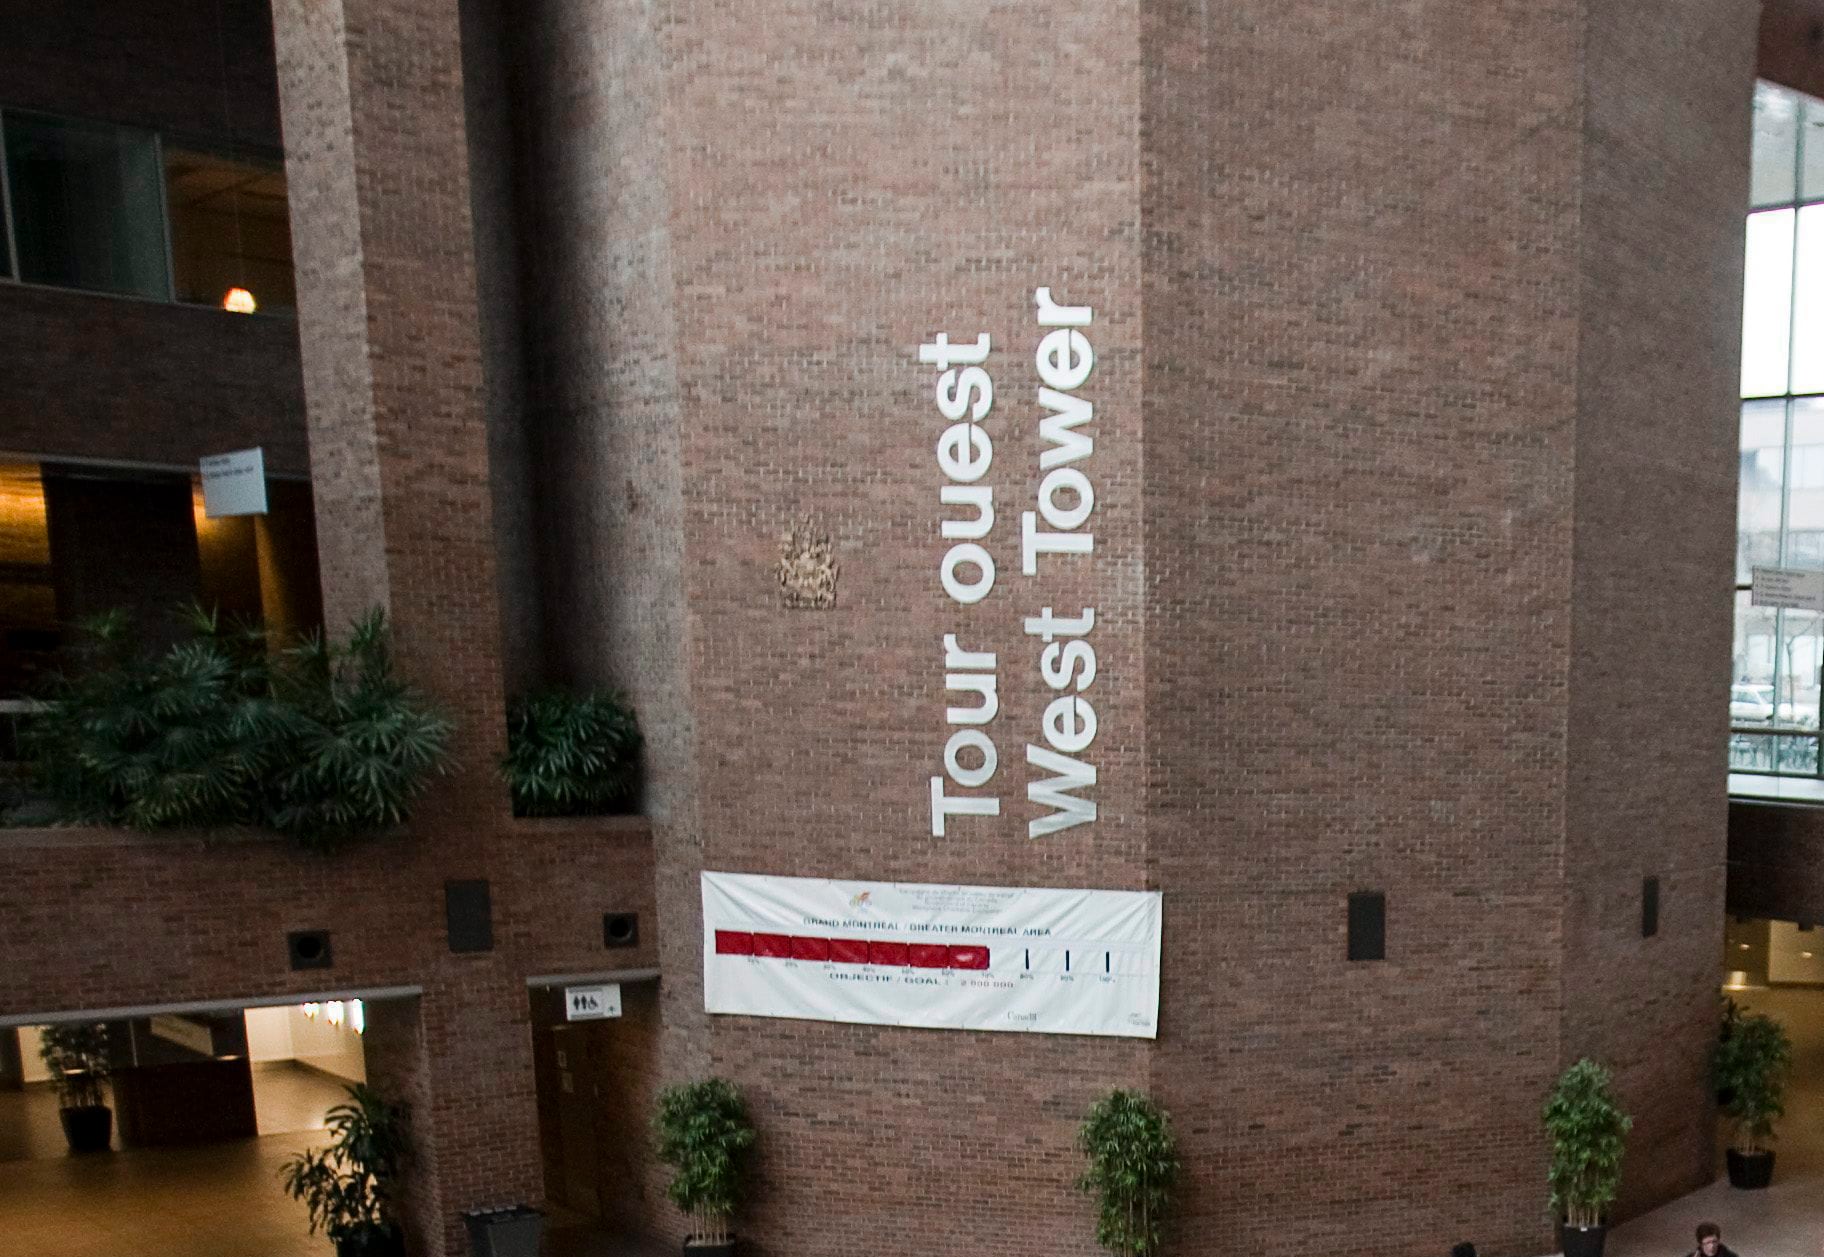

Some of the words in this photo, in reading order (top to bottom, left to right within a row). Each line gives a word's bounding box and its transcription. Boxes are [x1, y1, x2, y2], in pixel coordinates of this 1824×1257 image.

[918, 332, 997, 605] ouest
[1021, 286, 1094, 576] Tower
[931, 634, 1000, 837] Tour
[1023, 606, 1098, 839] West
